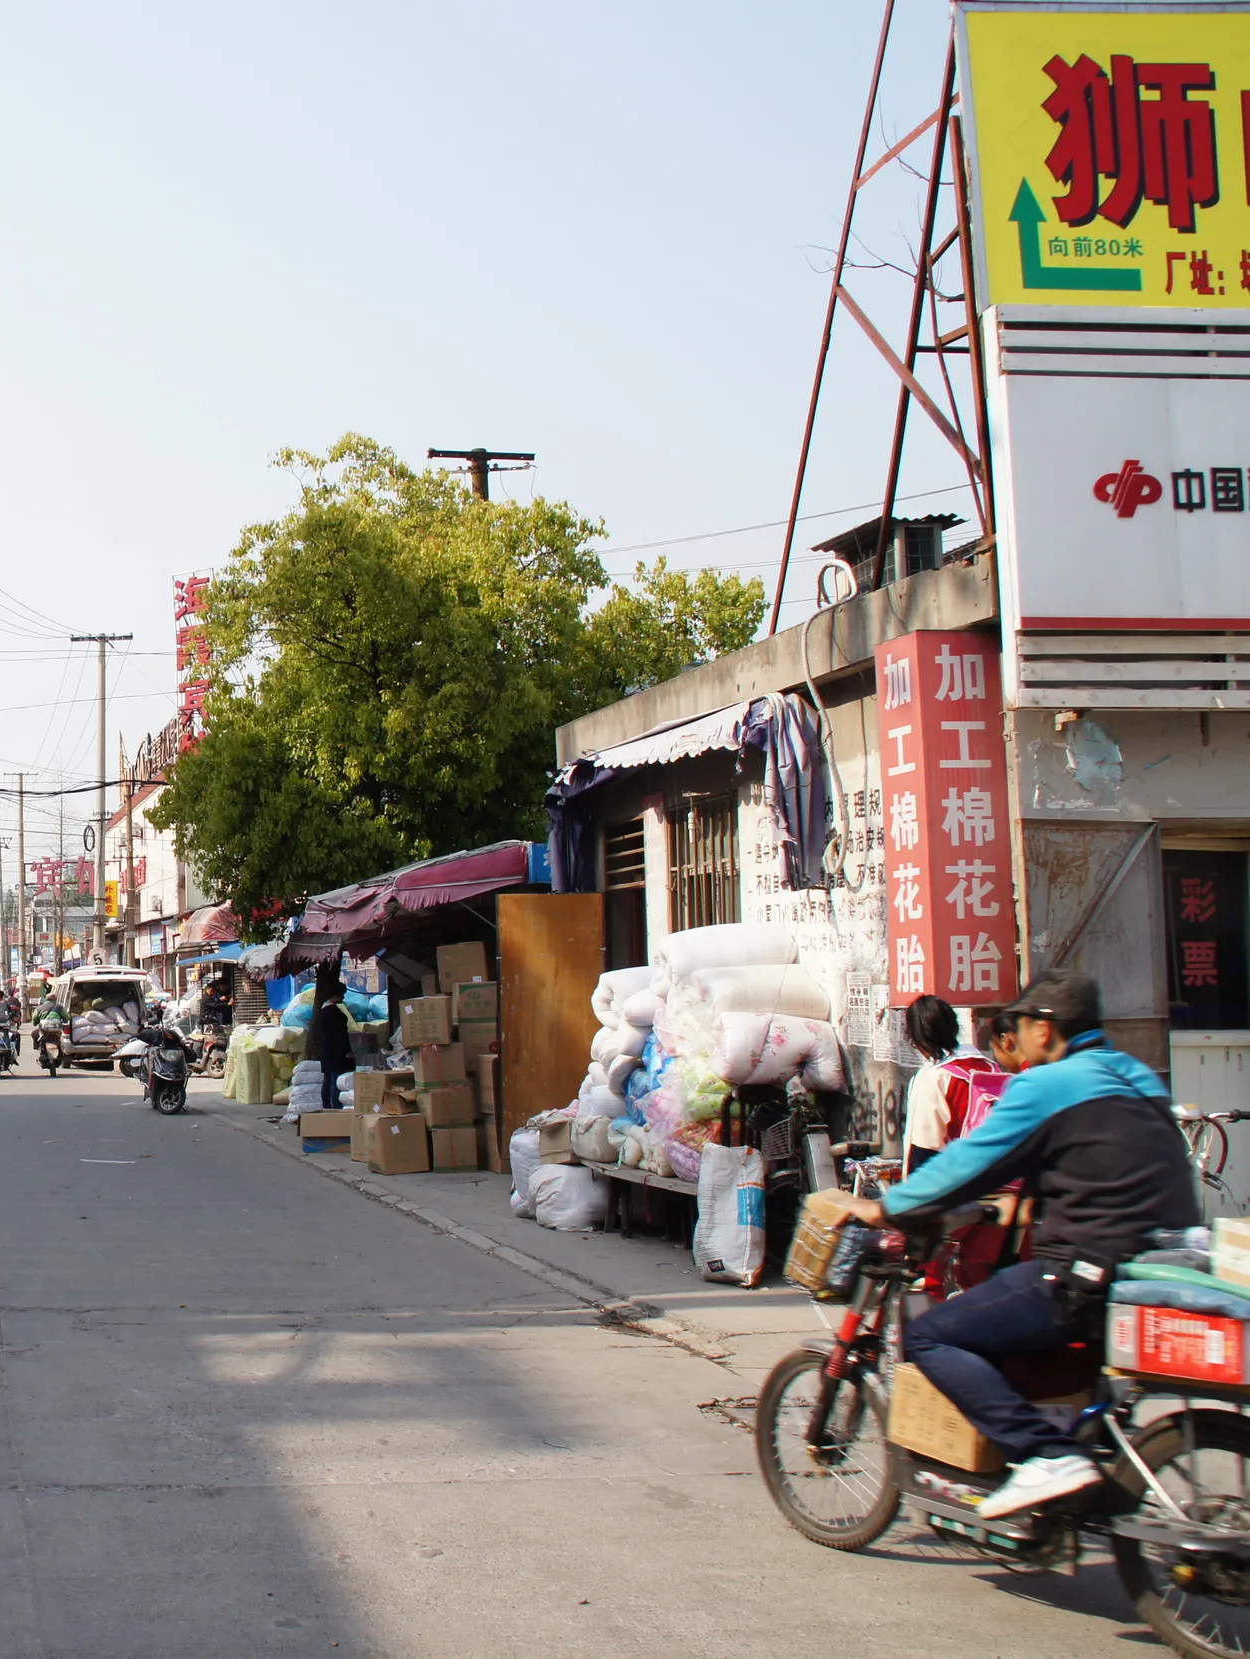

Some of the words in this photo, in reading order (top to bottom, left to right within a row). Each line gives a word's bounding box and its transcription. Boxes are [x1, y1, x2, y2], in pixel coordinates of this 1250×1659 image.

[1041, 53, 1250, 234] 狮
[1048, 236, 1144, 258] 向前80米
[1171, 466, 1250, 513] 中国
[883, 652, 926, 994] 加工棉花胎
[934, 643, 1003, 992] 加工棉花胎
[1180, 878, 1218, 986] 彩票
